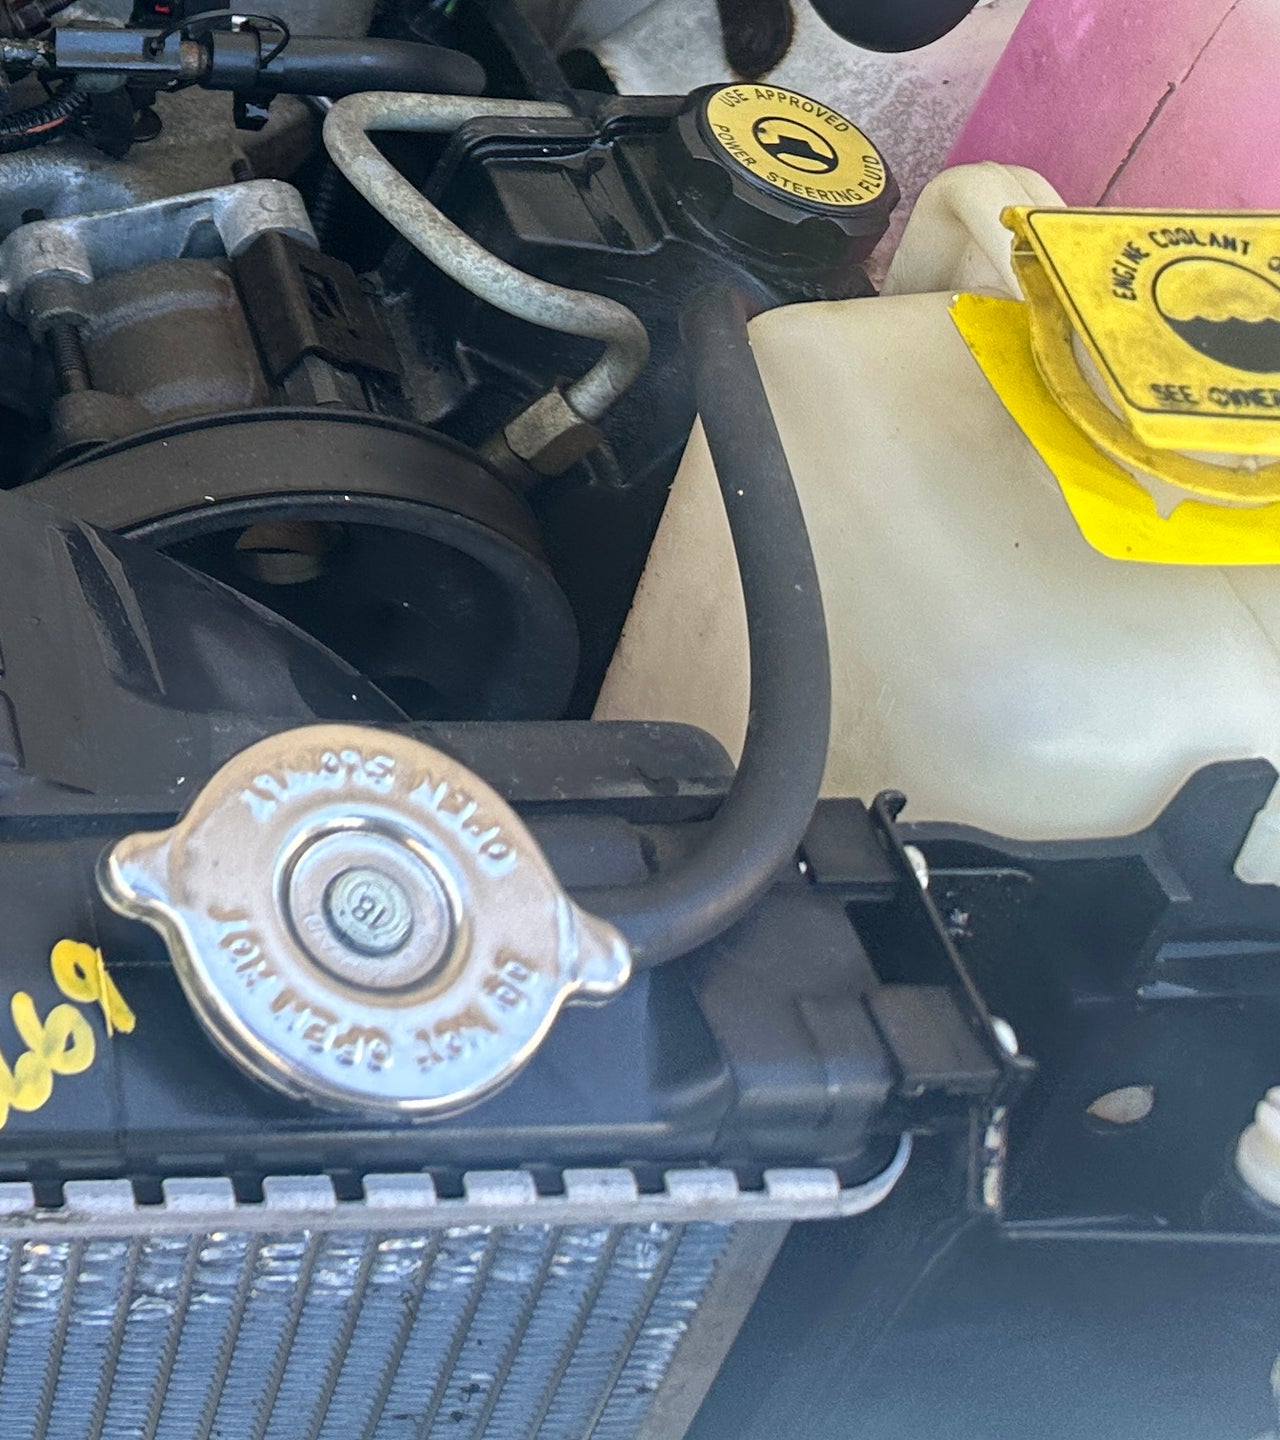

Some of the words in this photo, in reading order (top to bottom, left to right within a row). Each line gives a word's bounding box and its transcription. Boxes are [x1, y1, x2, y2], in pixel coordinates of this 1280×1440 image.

[719, 88, 749, 108] USE
[754, 87, 851, 134] APPROVED
[712, 122, 758, 168] POWER
[766, 170, 865, 203] STEERING
[857, 155, 882, 195] FLUID
[1112, 240, 1150, 302] ENGINE
[1148, 226, 1251, 257] COOLANT
[1149, 383, 1200, 405] SEE
[407, 776, 519, 879] OPEN
[483, 947, 538, 1011] DO
[269, 990, 393, 1074] OPEN
[413, 1004, 498, 1074] NOT
